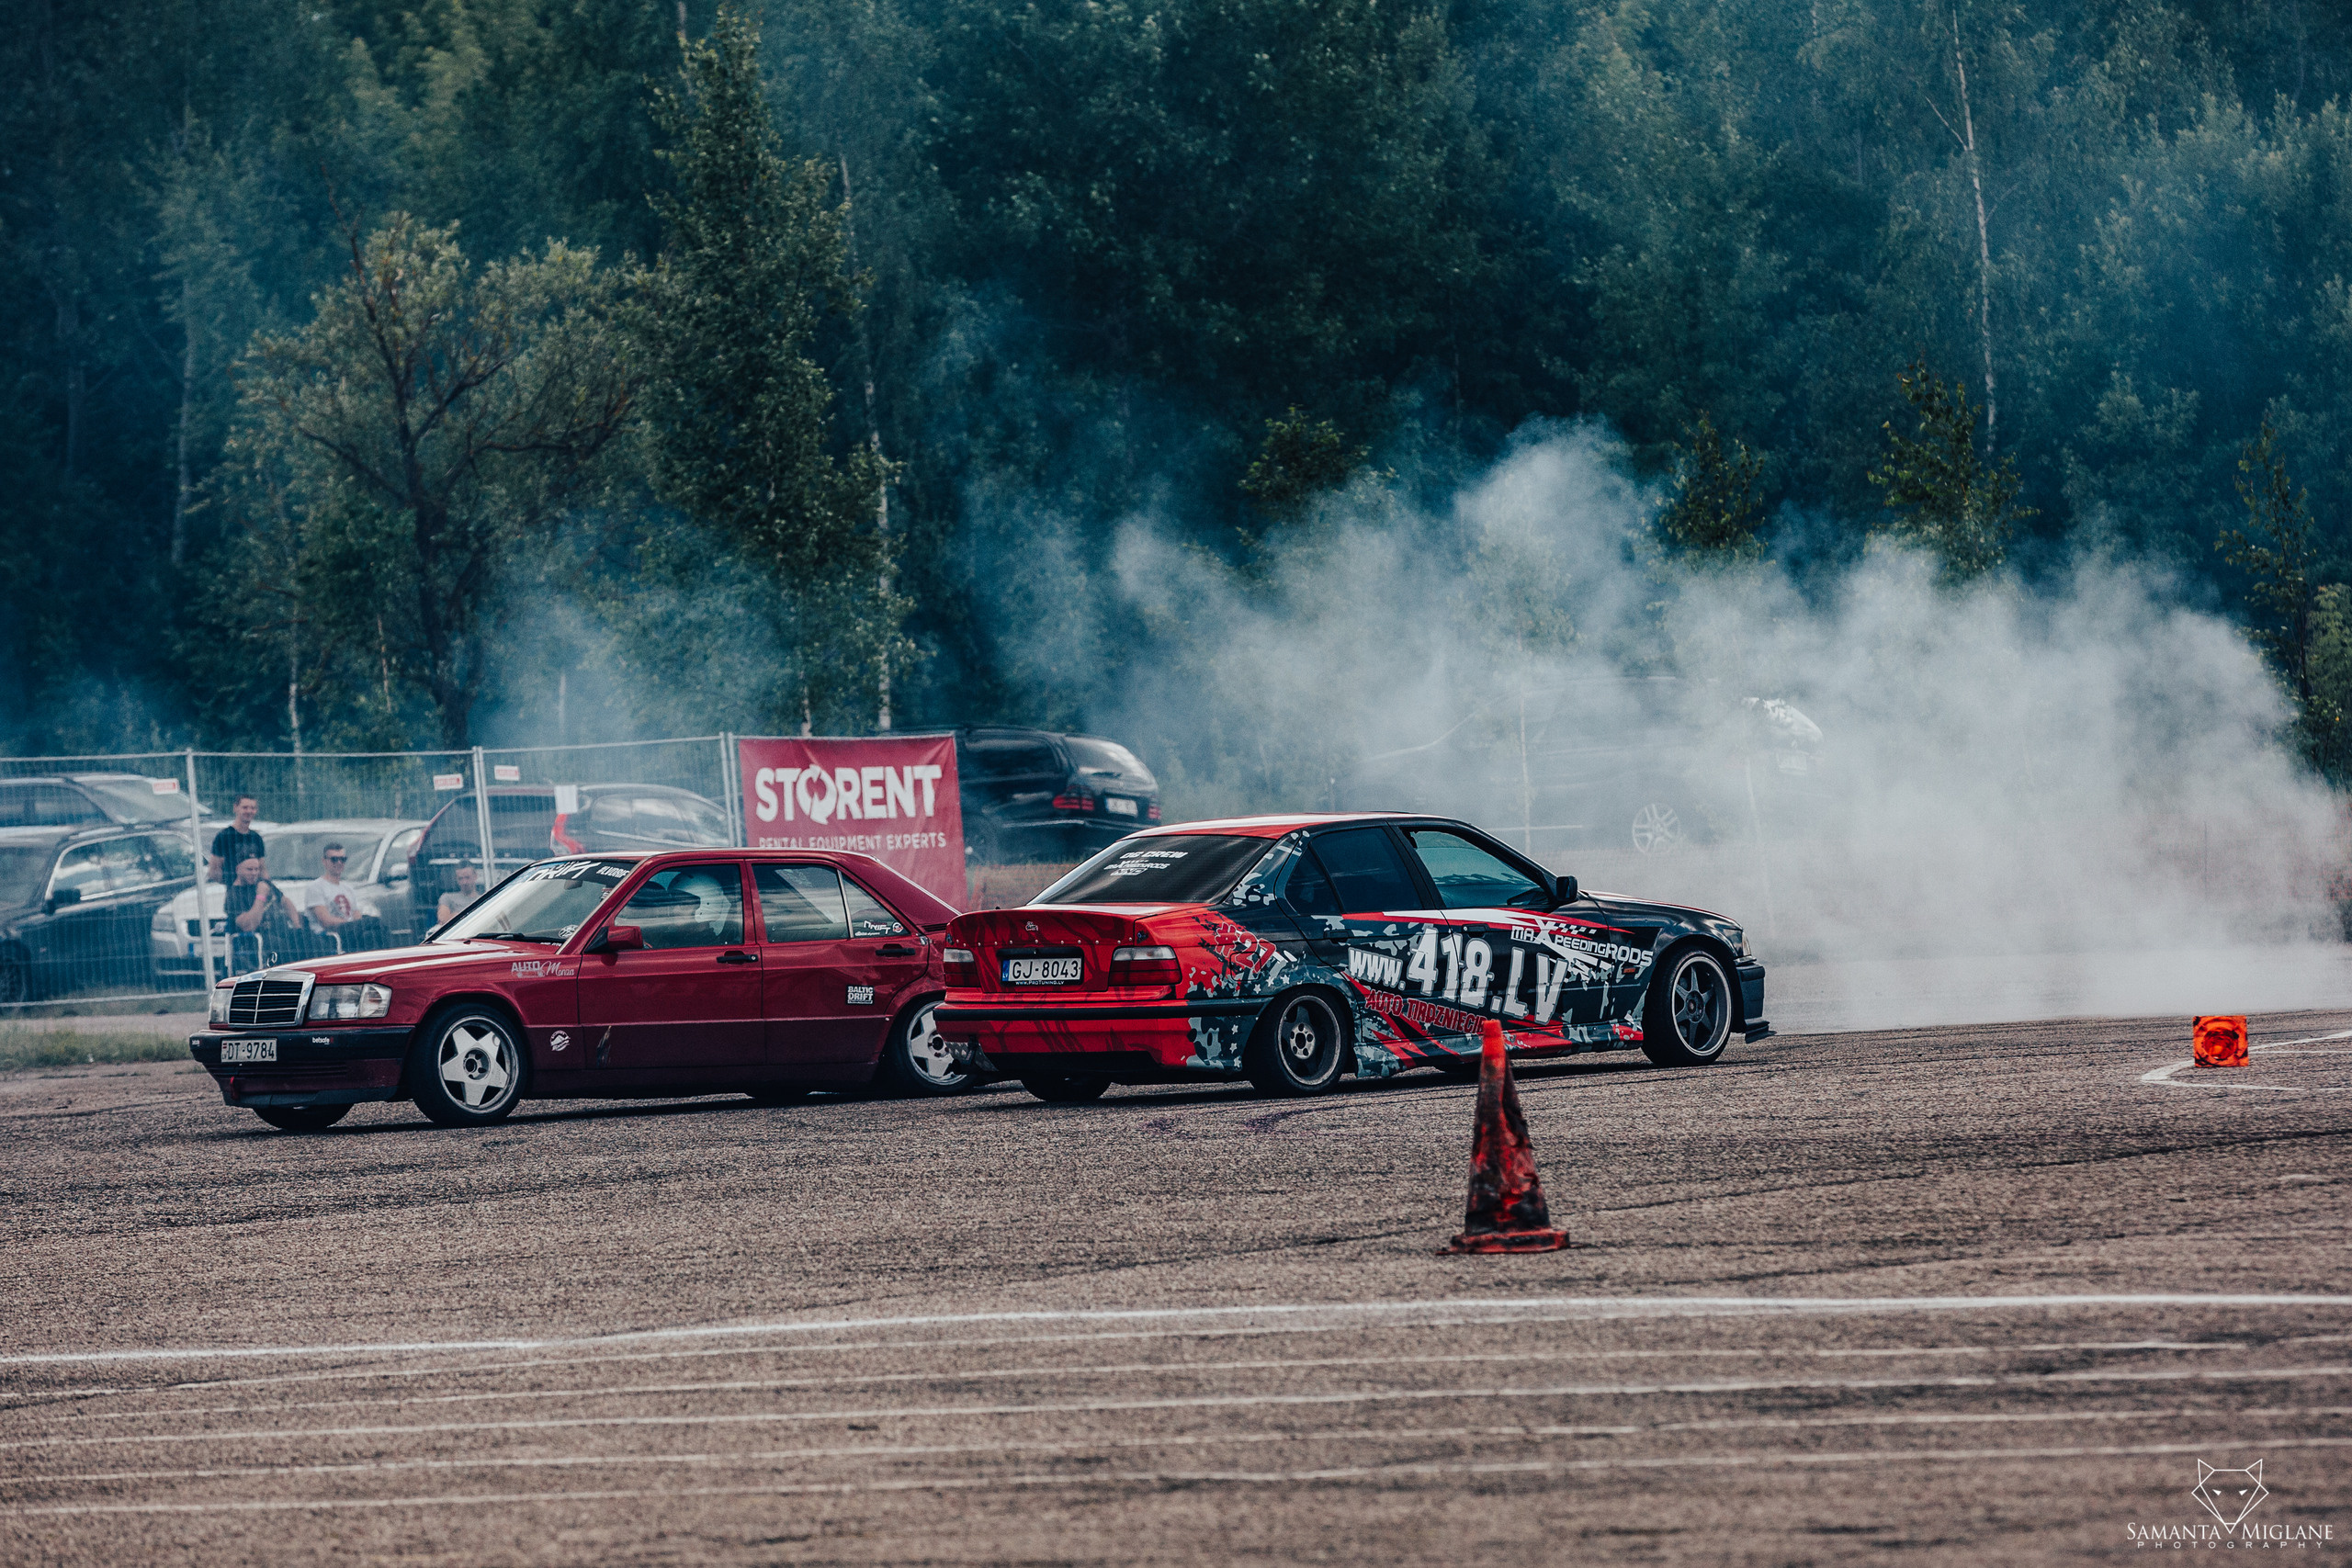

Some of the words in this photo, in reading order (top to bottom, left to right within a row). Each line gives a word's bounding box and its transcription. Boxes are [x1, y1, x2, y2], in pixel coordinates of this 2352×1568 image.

[755, 763, 943, 825] STORENT
[808, 835, 881, 852] EQUIPMENT
[886, 831, 947, 850] EXPERTS
[511, 961, 540, 972] AUTO
[1012, 960, 1079, 979] GJ-8043
[1364, 989, 1404, 1015] AUTO
[1407, 997, 1492, 1034] TIRDZNIECIB
